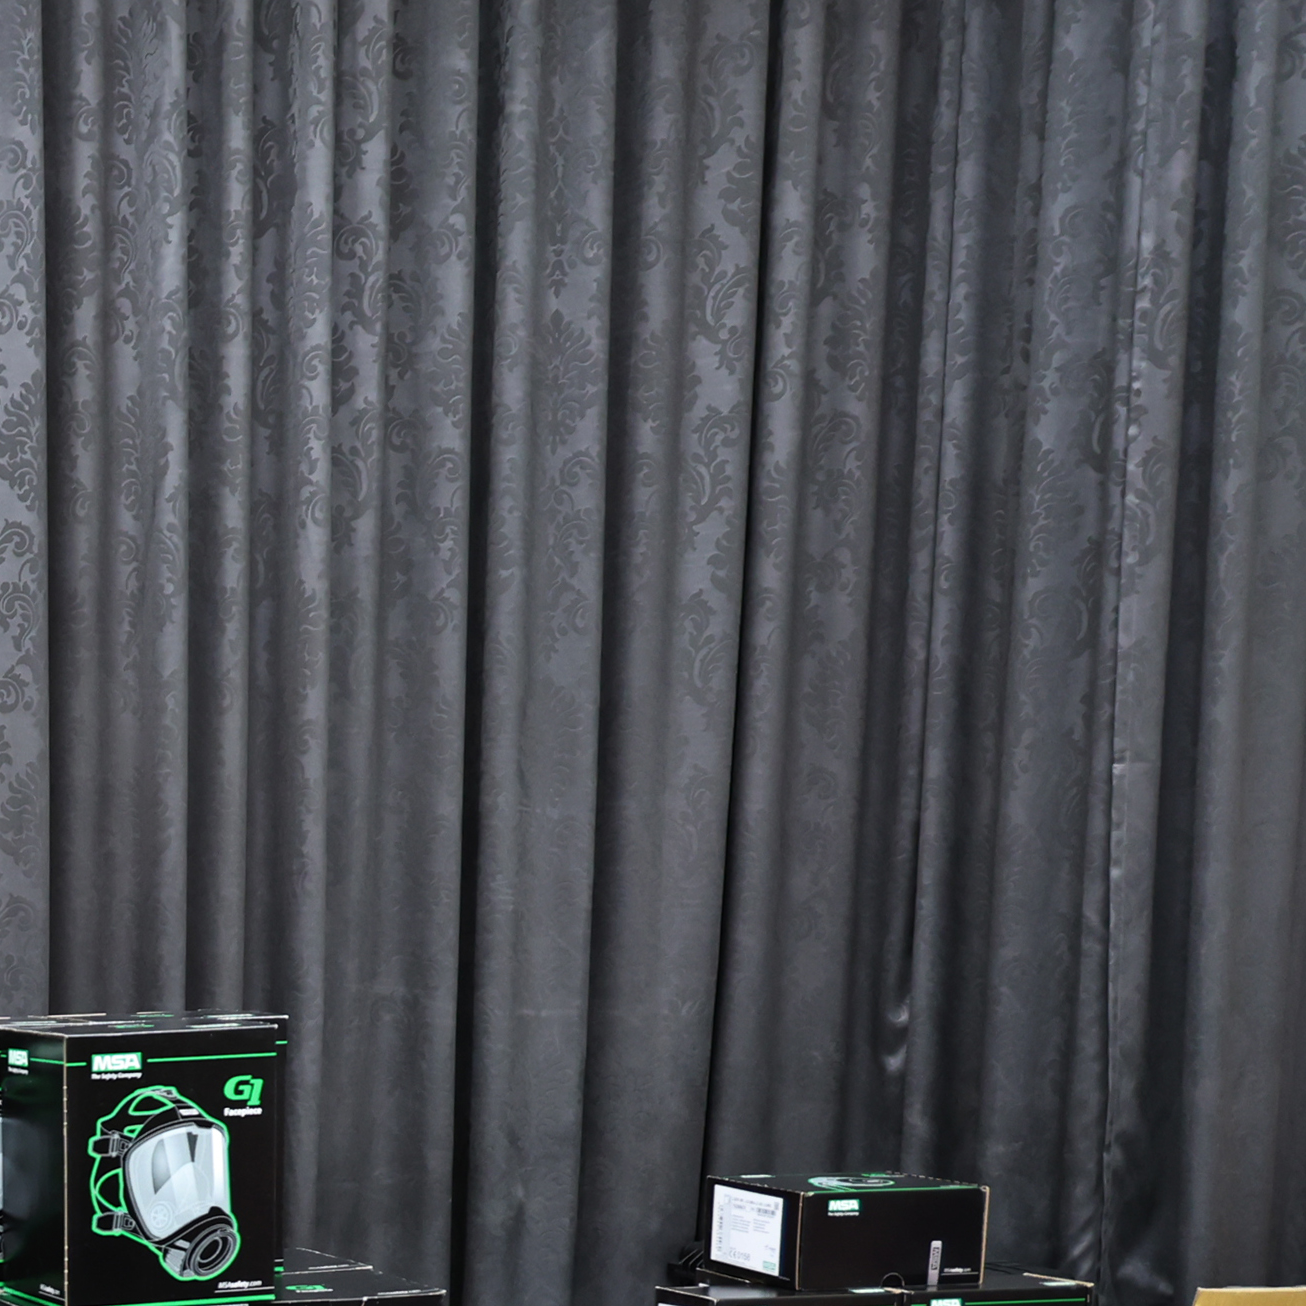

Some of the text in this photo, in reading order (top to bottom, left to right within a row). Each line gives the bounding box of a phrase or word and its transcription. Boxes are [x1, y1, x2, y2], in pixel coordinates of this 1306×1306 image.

[92, 1052, 142, 1072] MSA
[223, 1075, 264, 1106] G1
[224, 1107, 262, 1117] Facepiece
[828, 1199, 859, 1211] MSA
